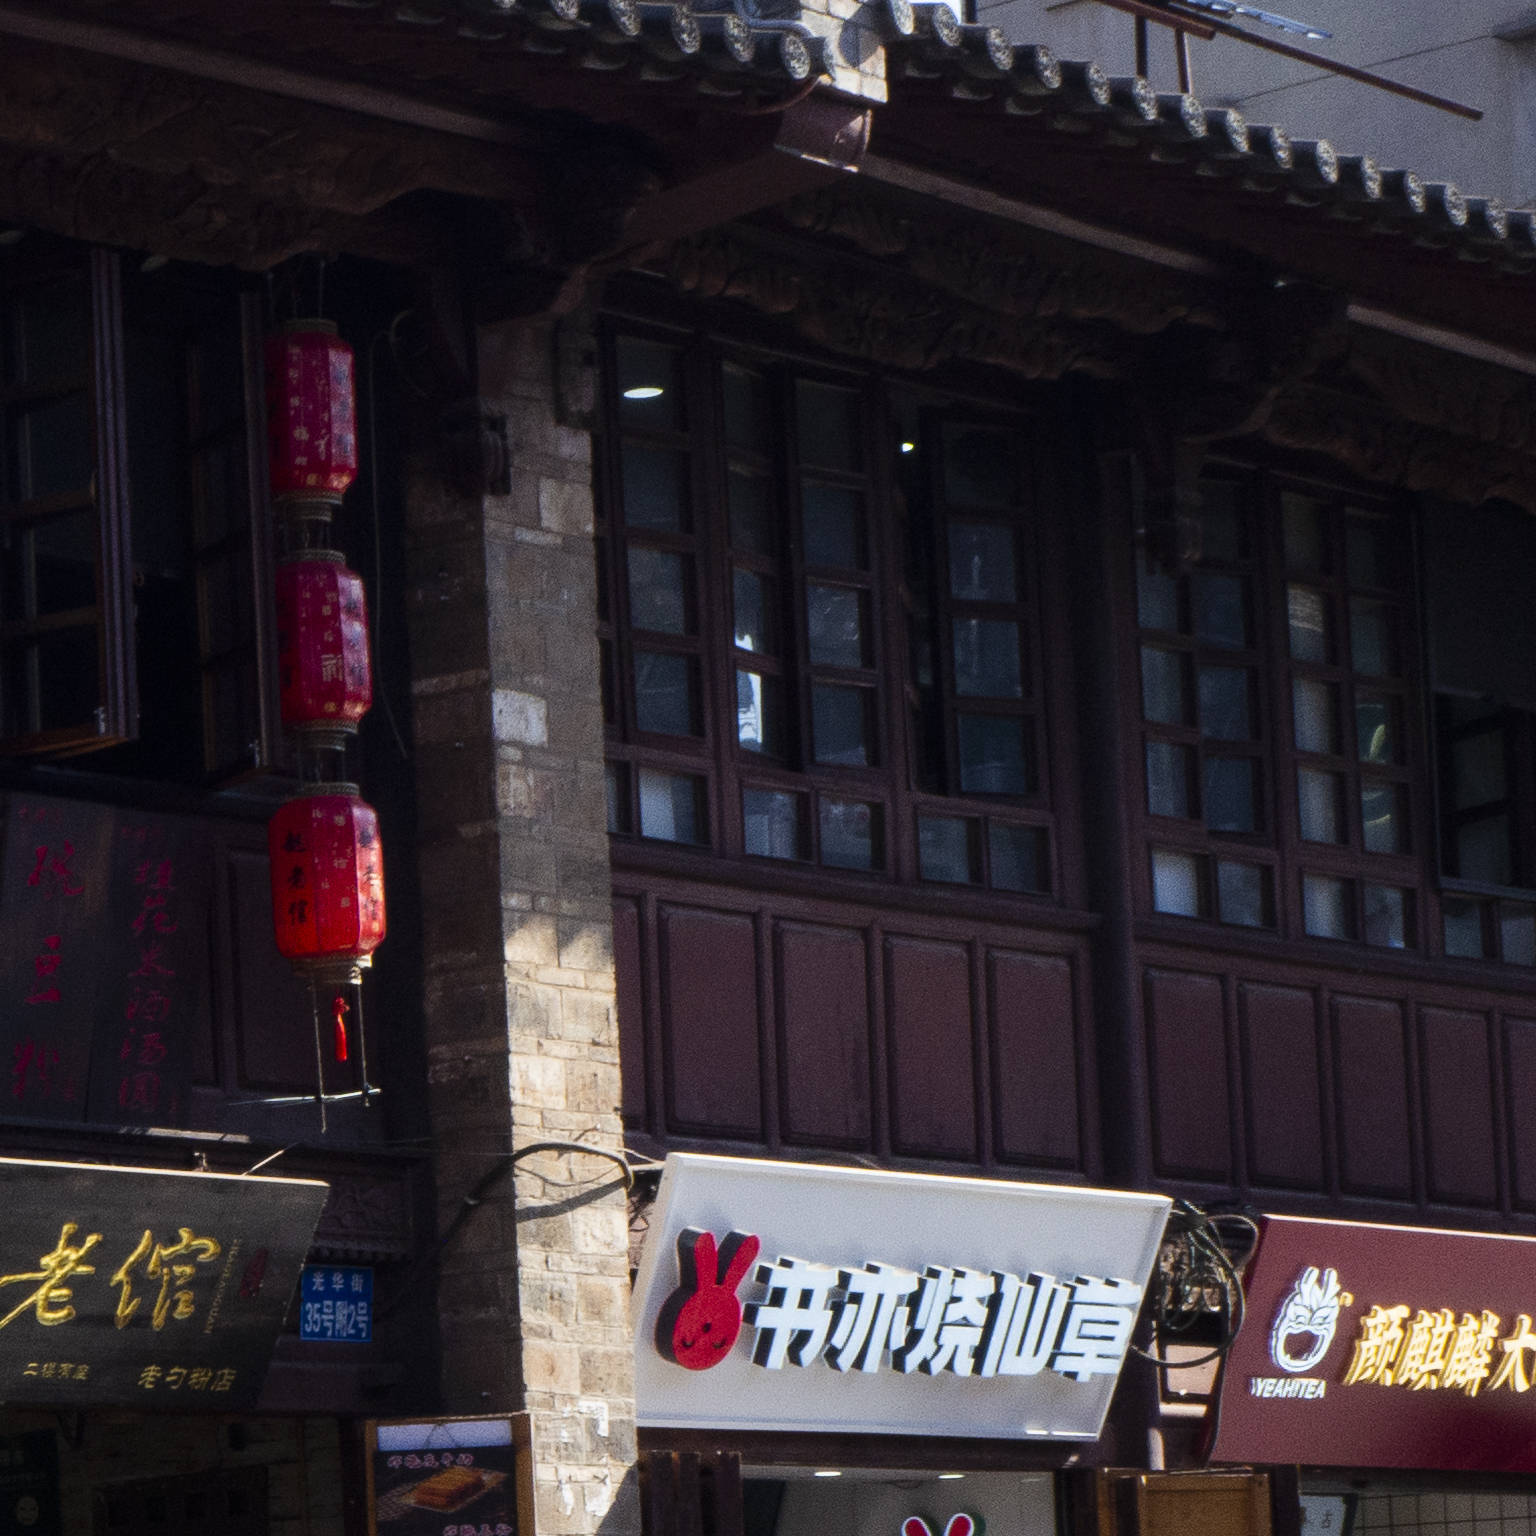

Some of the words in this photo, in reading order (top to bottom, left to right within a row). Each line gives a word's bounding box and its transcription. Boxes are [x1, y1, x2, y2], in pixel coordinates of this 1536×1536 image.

[311, 1271, 364, 1293] 光华街
[304, 1299, 369, 1339] 35号附2号
[749, 1256, 1143, 1383] 书亦烧仙草
